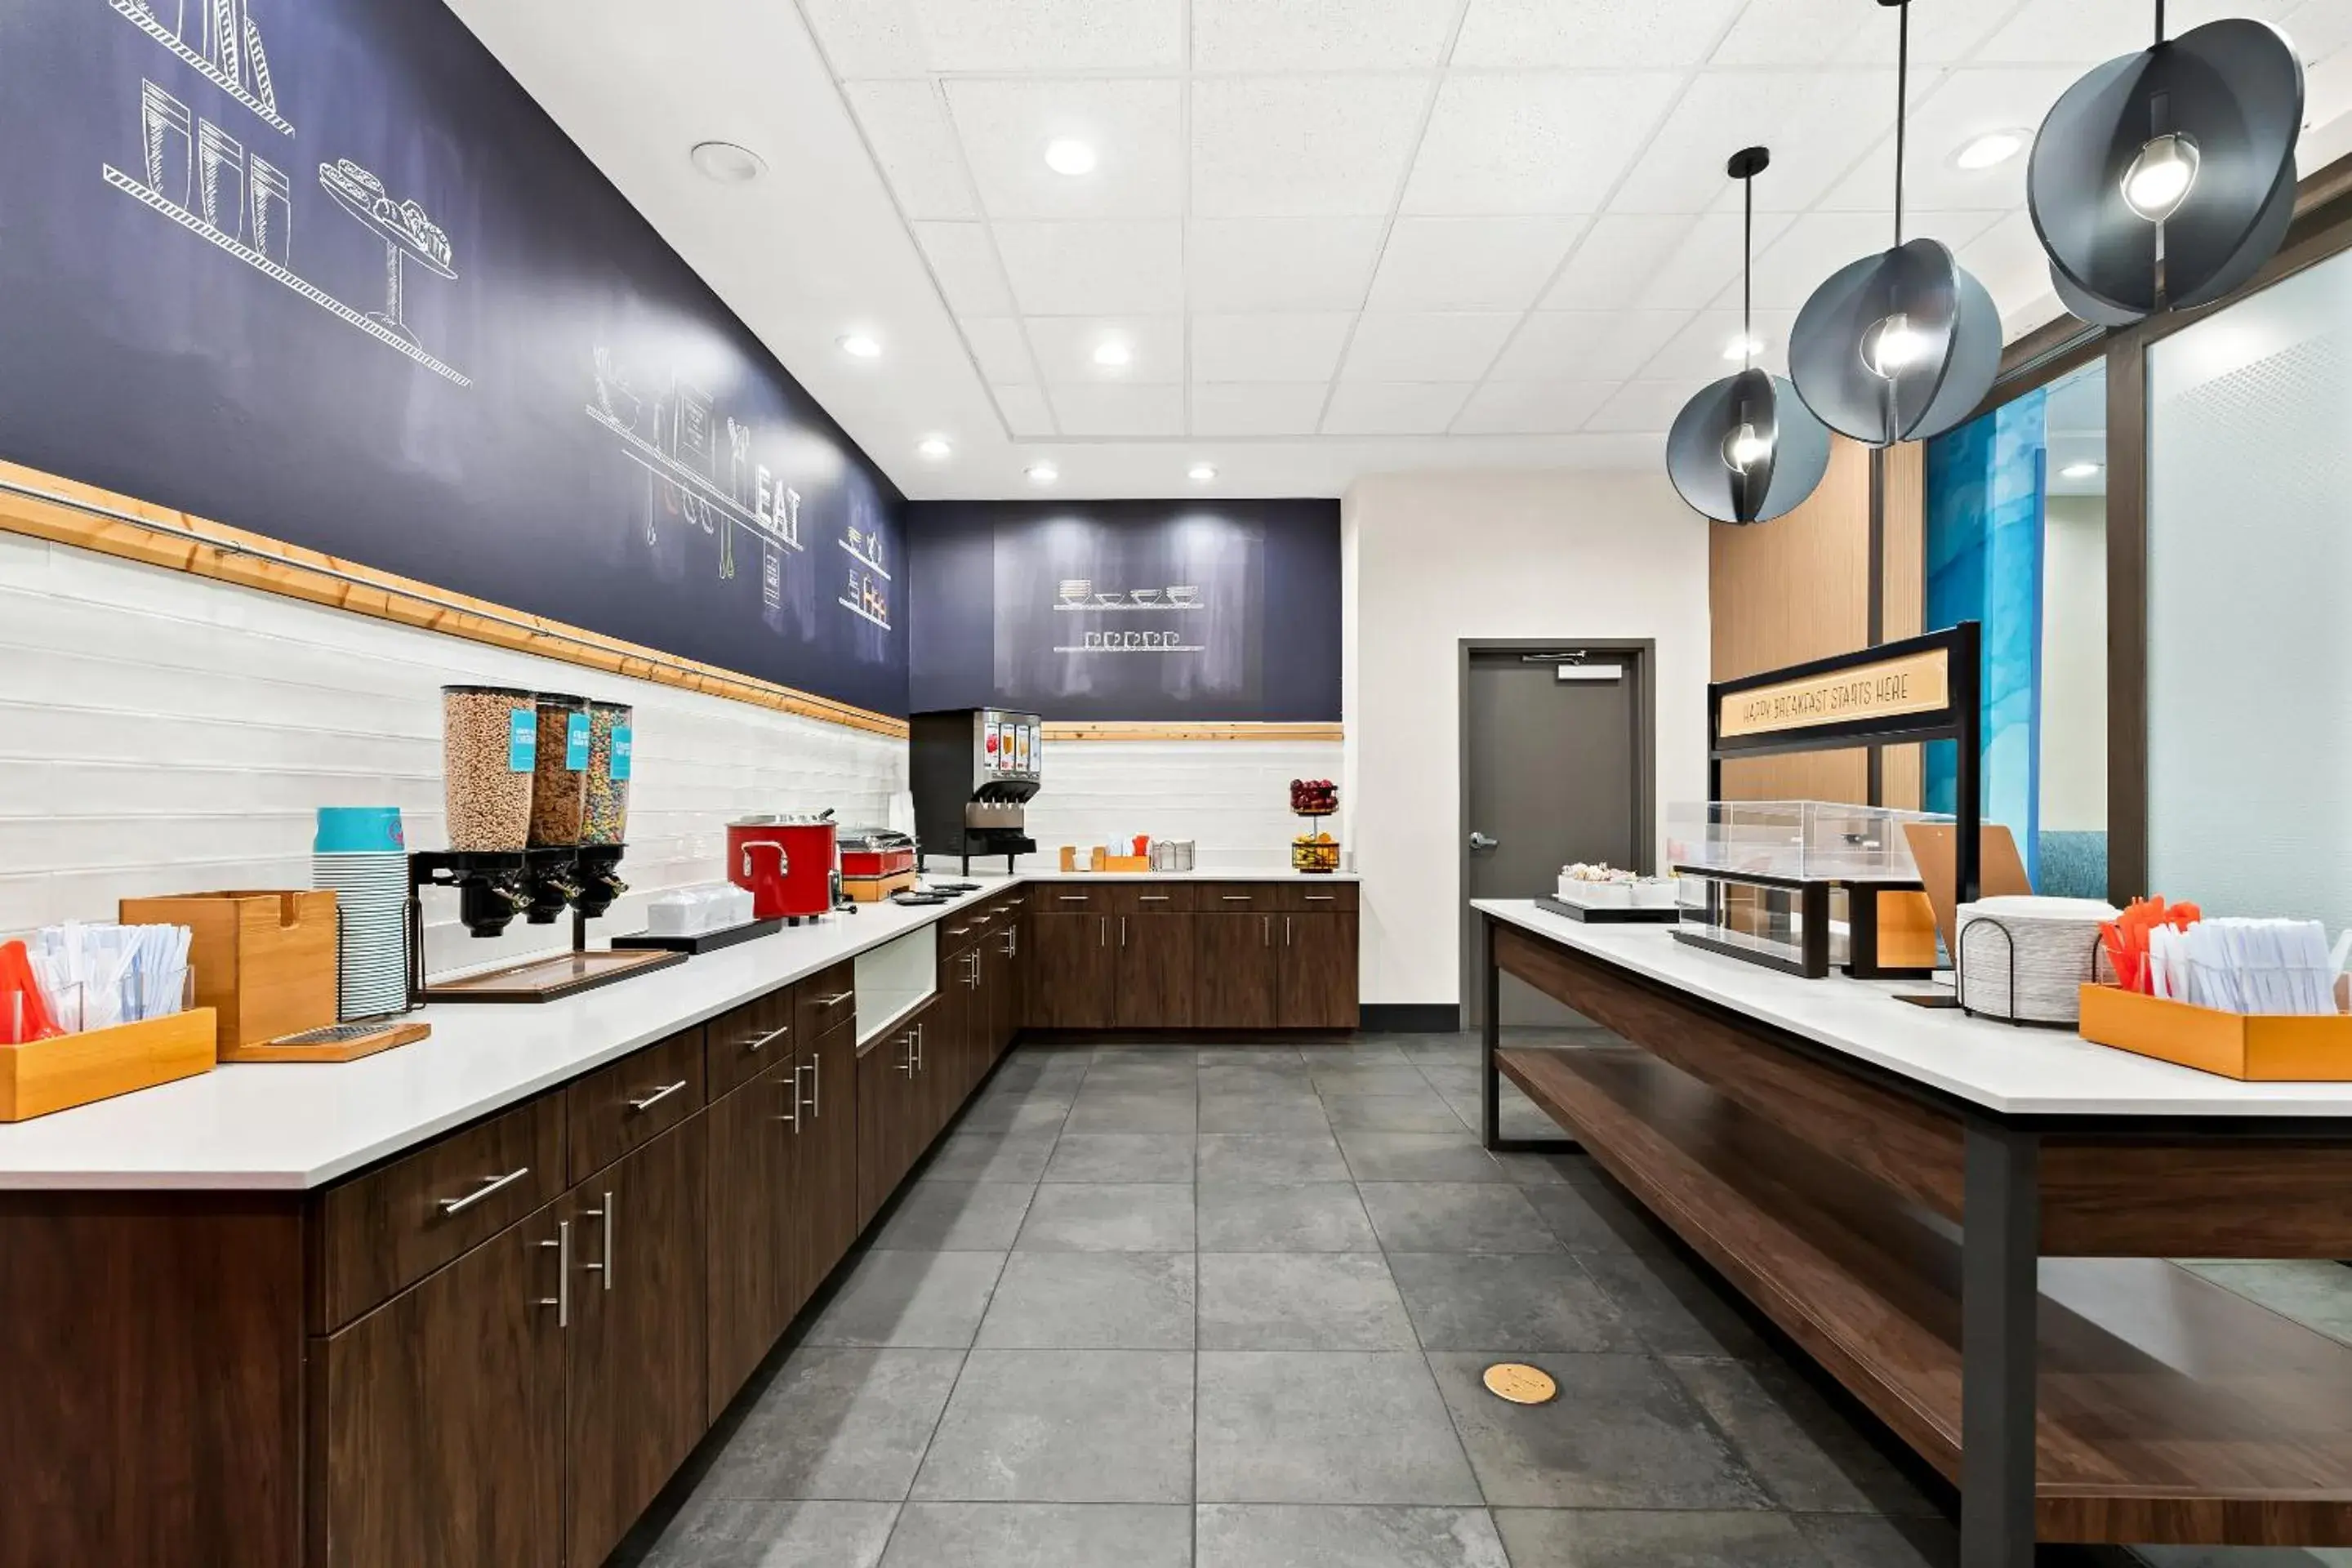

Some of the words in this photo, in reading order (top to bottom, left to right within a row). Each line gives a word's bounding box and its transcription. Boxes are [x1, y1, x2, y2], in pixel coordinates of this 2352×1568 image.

[755, 464, 800, 542] EAT
[1744, 698, 1771, 724] HAPPY
[1774, 689, 1828, 719] BREAKFAST
[1830, 681, 1872, 709] STARTS
[1876, 674, 1908, 702] HERE
